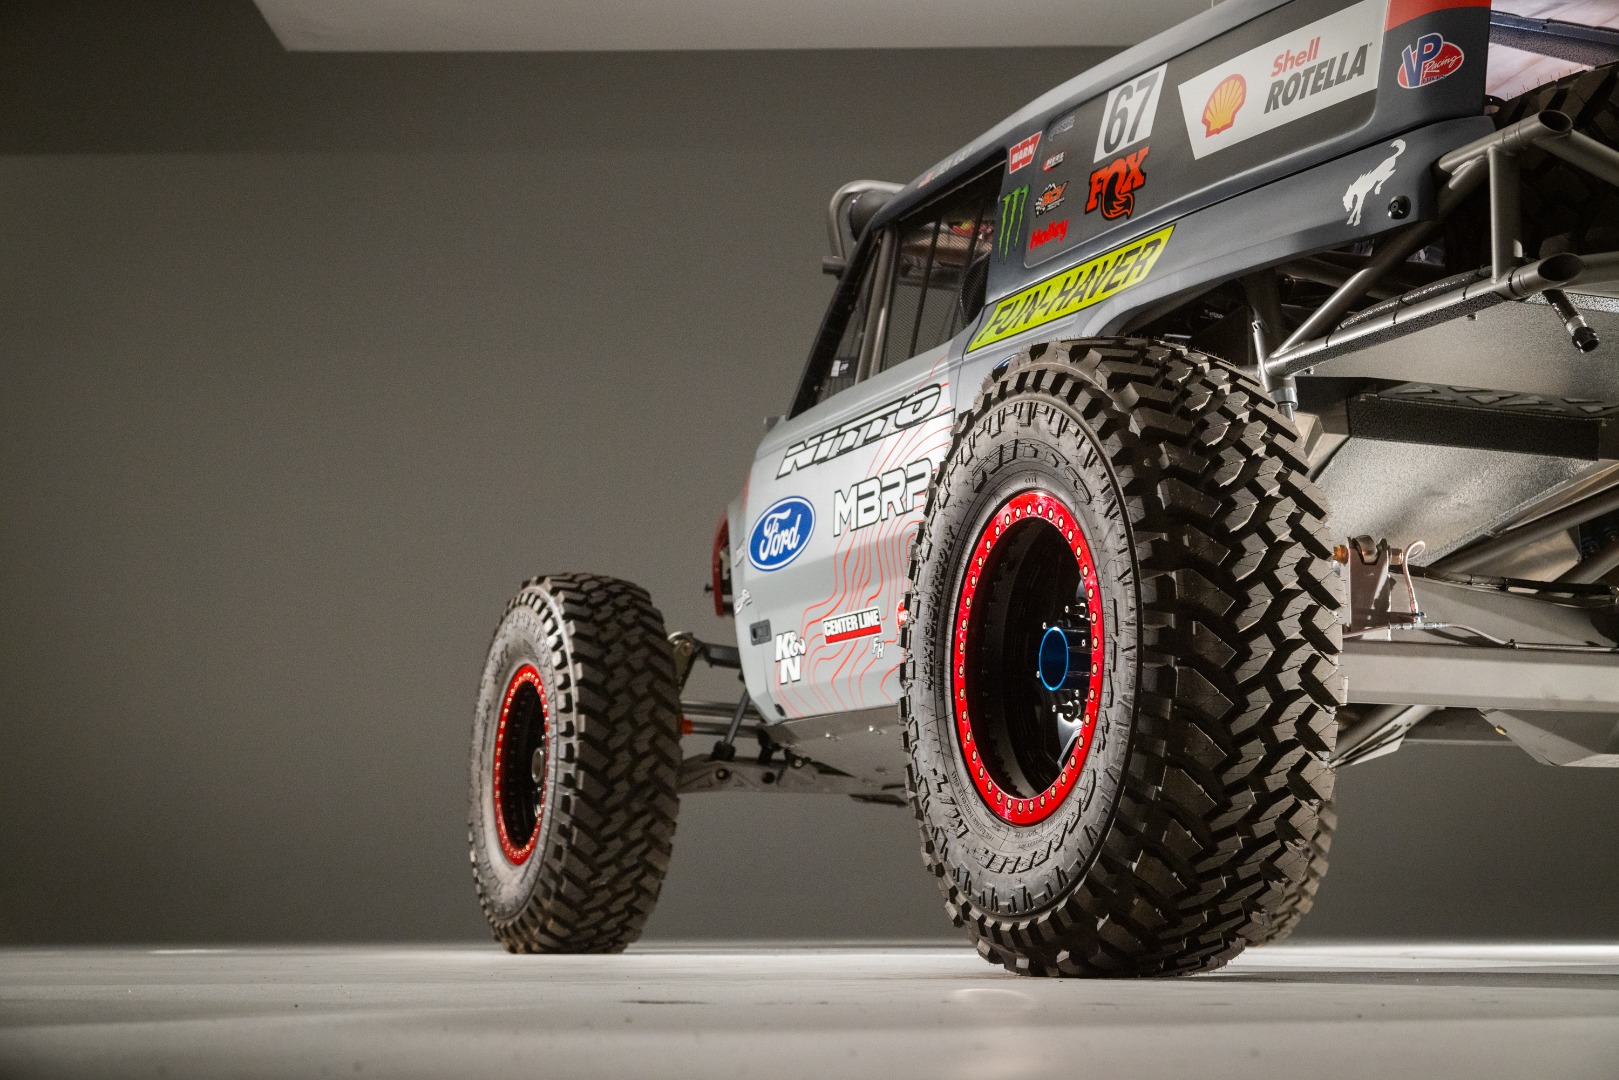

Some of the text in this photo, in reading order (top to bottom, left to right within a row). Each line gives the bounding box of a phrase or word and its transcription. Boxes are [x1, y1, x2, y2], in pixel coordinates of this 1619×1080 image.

[1263, 42, 1369, 114] ROTELLA
[1270, 35, 1321, 77] Shell
[1402, 33, 1443, 88] VP
[1423, 55, 1462, 78] Racing
[1103, 71, 1160, 154] 67
[1011, 143, 1035, 165] WARN
[1085, 145, 1149, 220] FOX
[1029, 218, 1069, 251] Holley
[976, 238, 1162, 343] FUN-HAVER
[833, 457, 934, 538] MBRP
[759, 508, 802, 561] Ford
[824, 607, 881, 637] CENTER LINE
